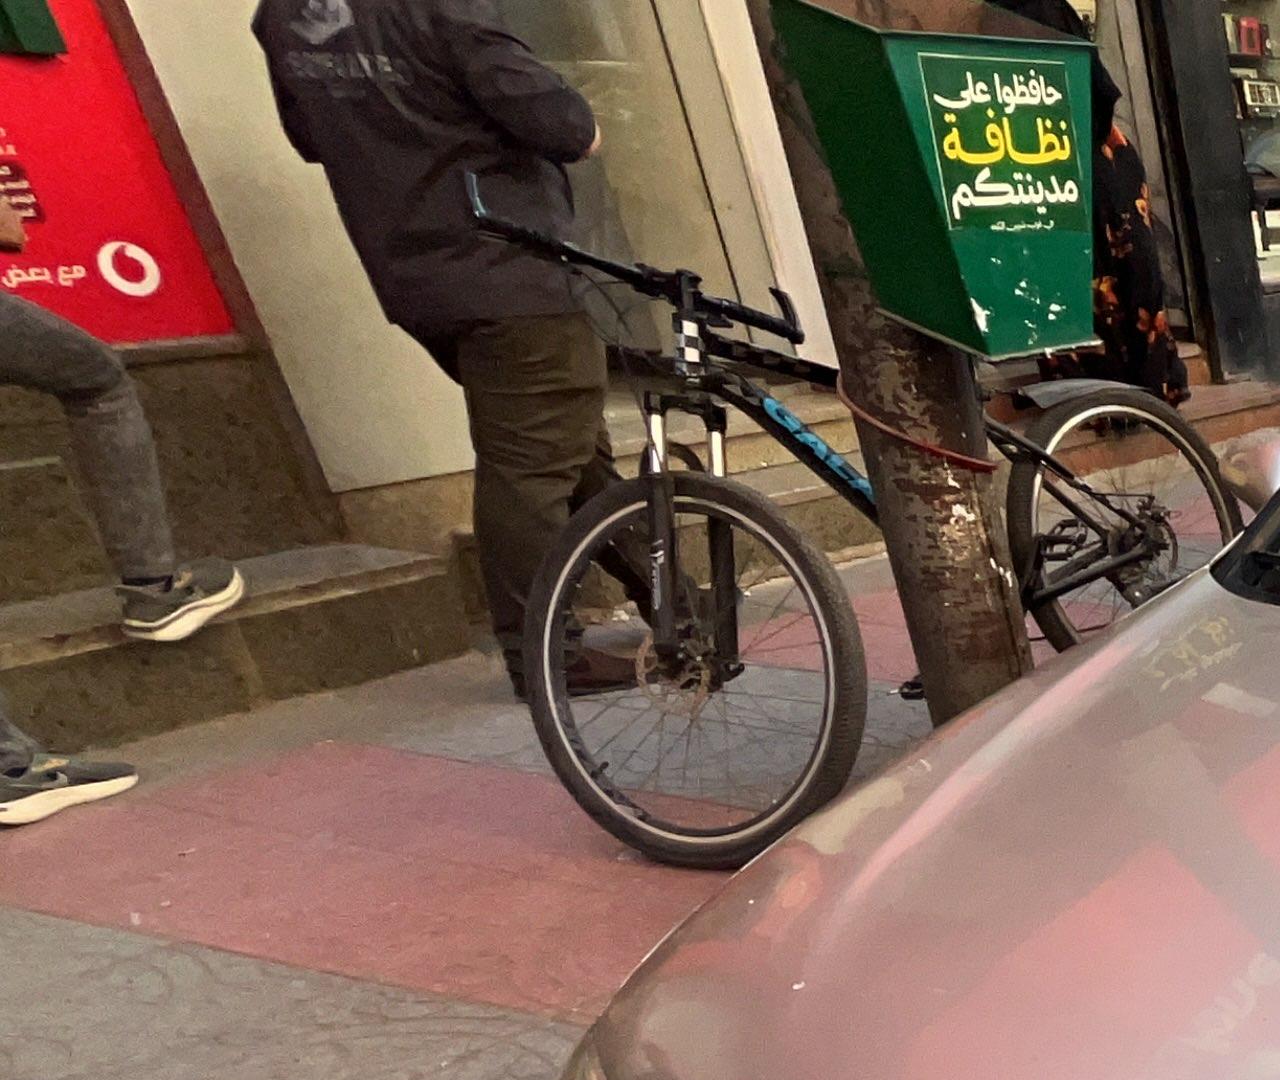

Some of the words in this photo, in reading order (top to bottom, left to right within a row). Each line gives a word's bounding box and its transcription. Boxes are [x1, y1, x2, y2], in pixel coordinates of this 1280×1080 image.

[933, 71, 992, 109] على
[993, 69, 1062, 114] حافظوا
[942, 108, 1071, 164] نظافة
[951, 167, 1078, 220] مدينتكم
[57, 264, 87, 288] مع
